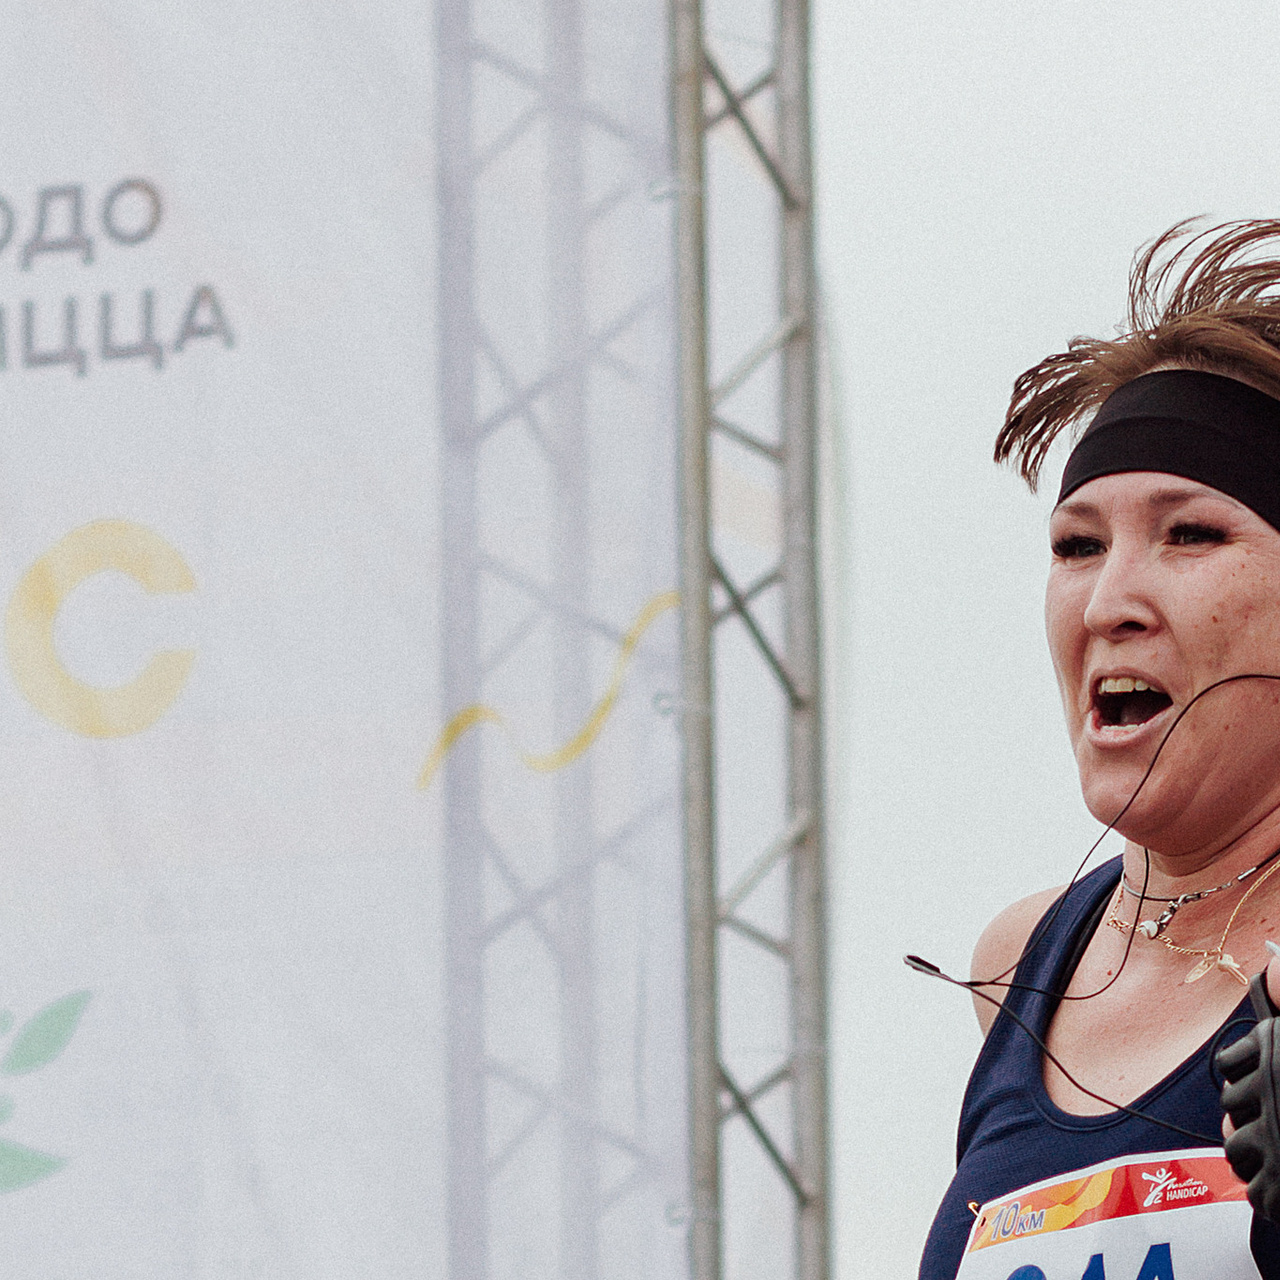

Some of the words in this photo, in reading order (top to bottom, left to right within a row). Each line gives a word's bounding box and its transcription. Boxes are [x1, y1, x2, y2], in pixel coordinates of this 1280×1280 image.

[0, 175, 164, 271] ДО
[0, 284, 237, 378] ЦЦА
[1166, 1185, 1209, 1201] HANDICAP
